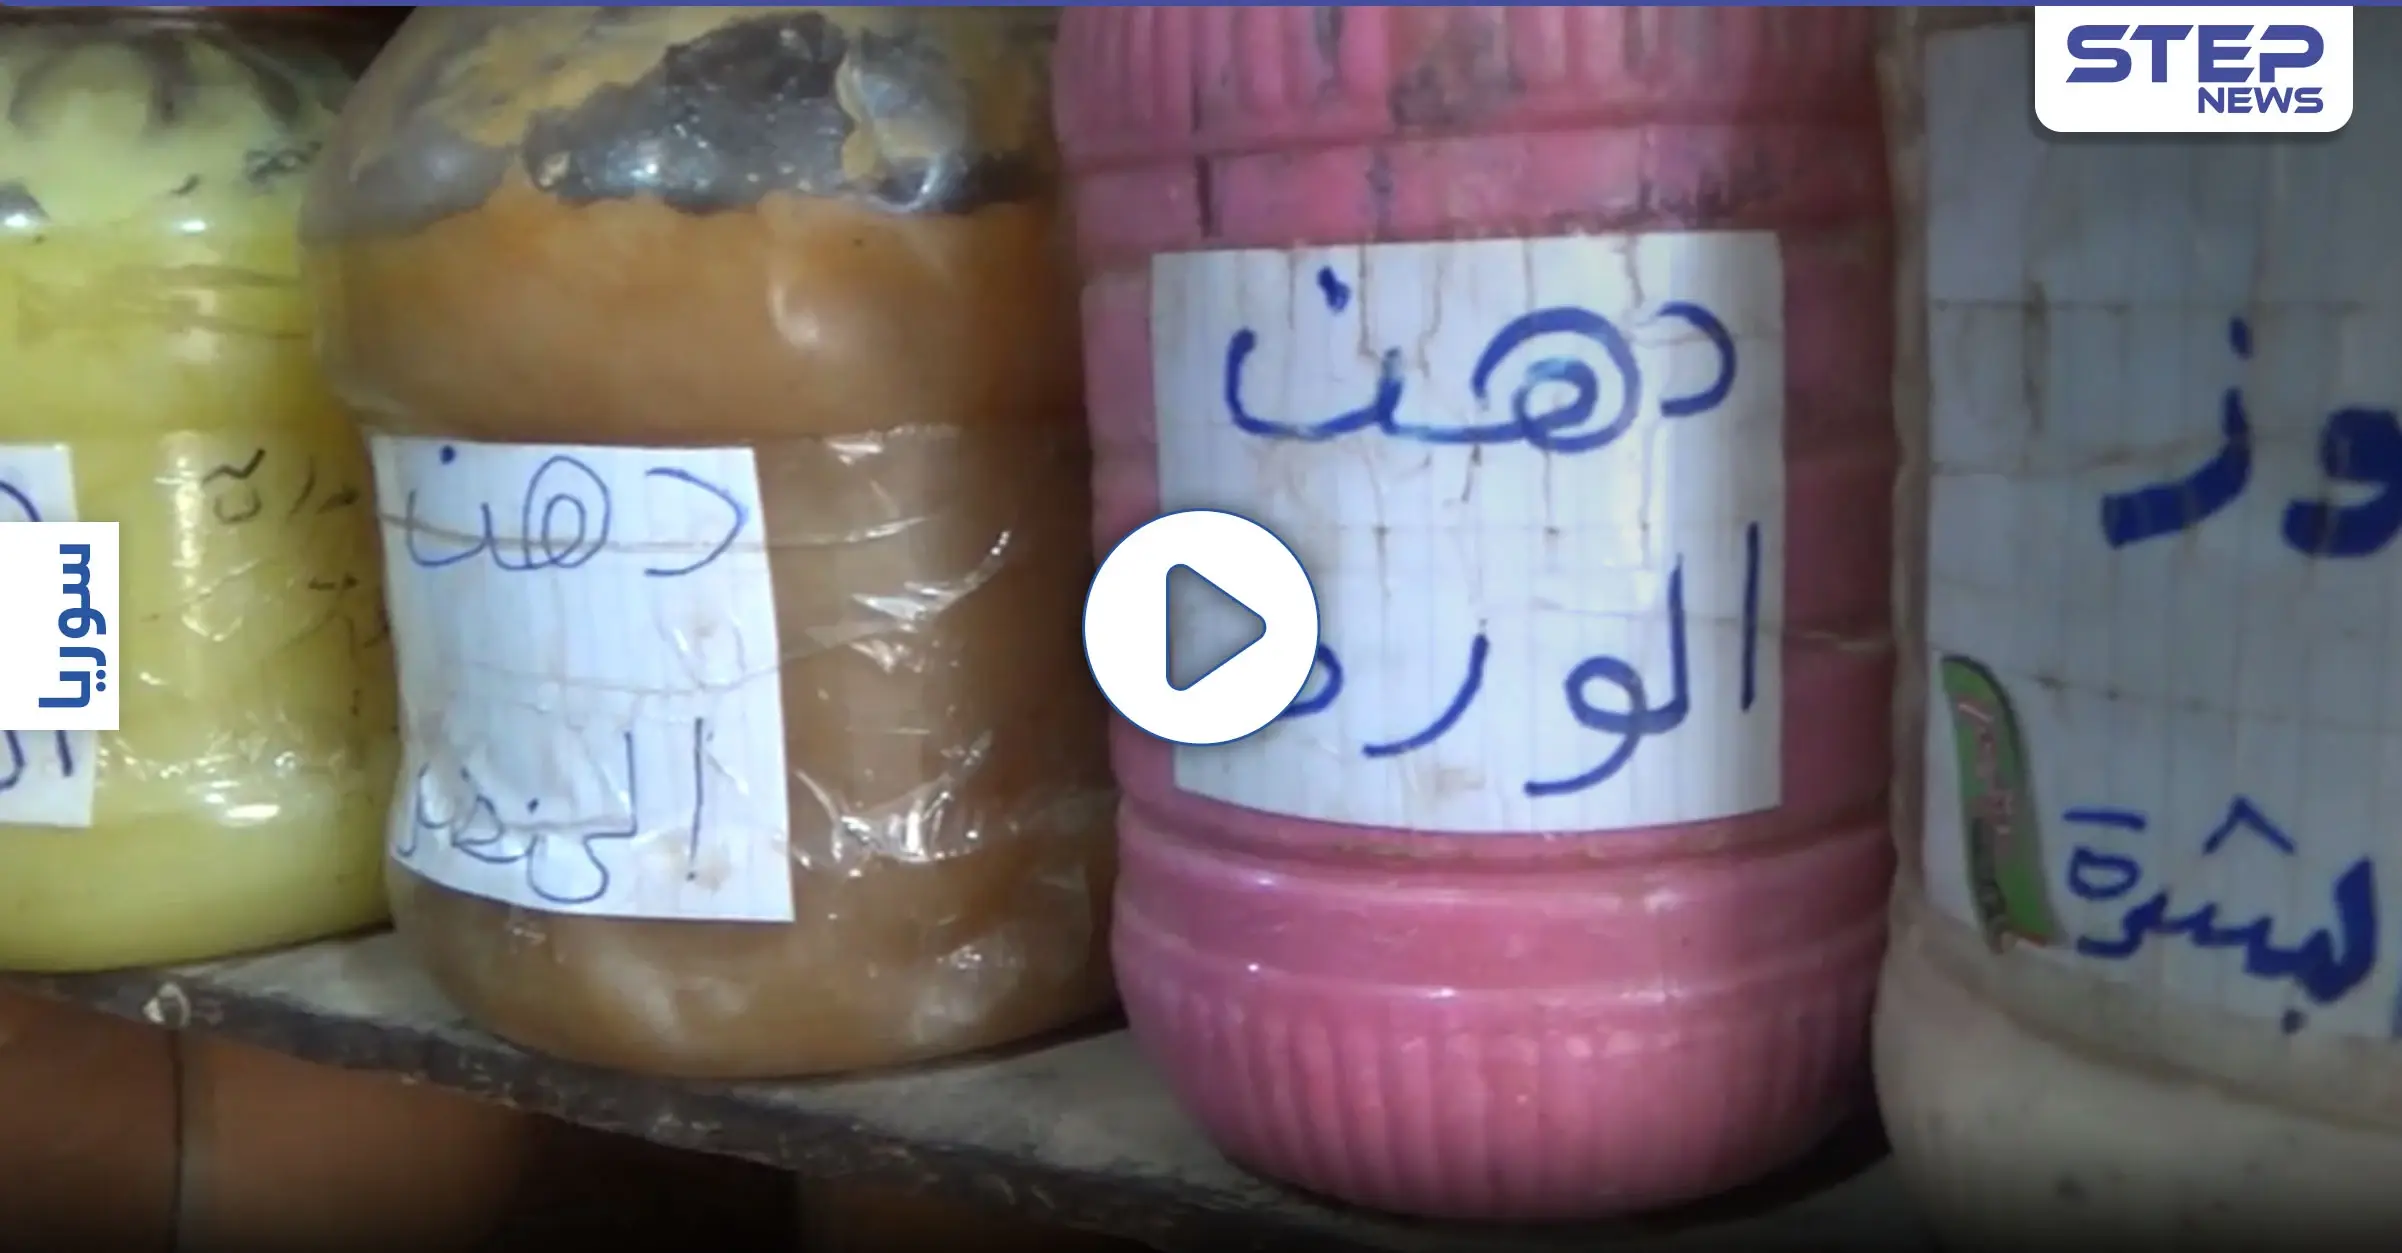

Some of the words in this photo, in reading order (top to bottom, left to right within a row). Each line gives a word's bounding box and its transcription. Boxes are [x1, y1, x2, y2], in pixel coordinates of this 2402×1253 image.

[1225, 265, 1736, 453] دهن
[407, 445, 748, 577] دهن
[2061, 797, 2402, 1034] لبشرة
